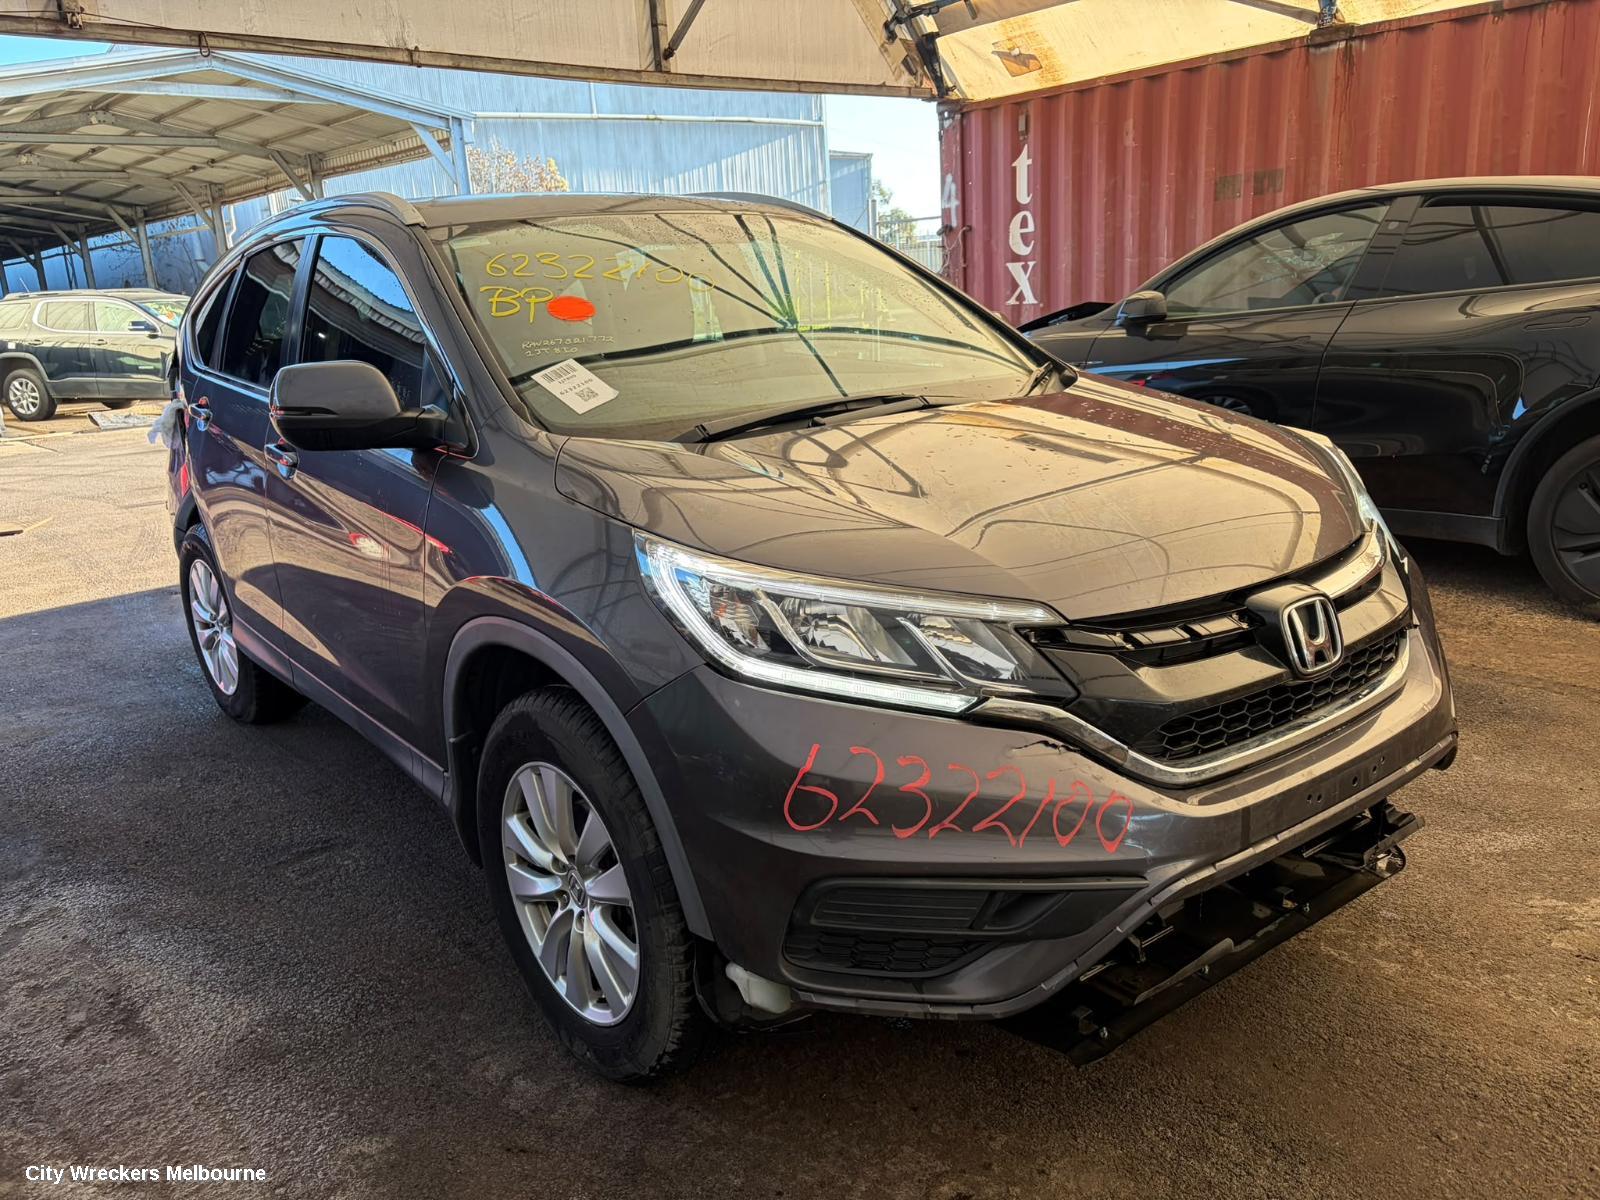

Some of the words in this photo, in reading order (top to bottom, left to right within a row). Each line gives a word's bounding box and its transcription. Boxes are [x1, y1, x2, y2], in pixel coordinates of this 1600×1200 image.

[486, 253, 715, 291] 62322100
[1005, 144, 1038, 305] tex
[783, 743, 1134, 853] 62322100
